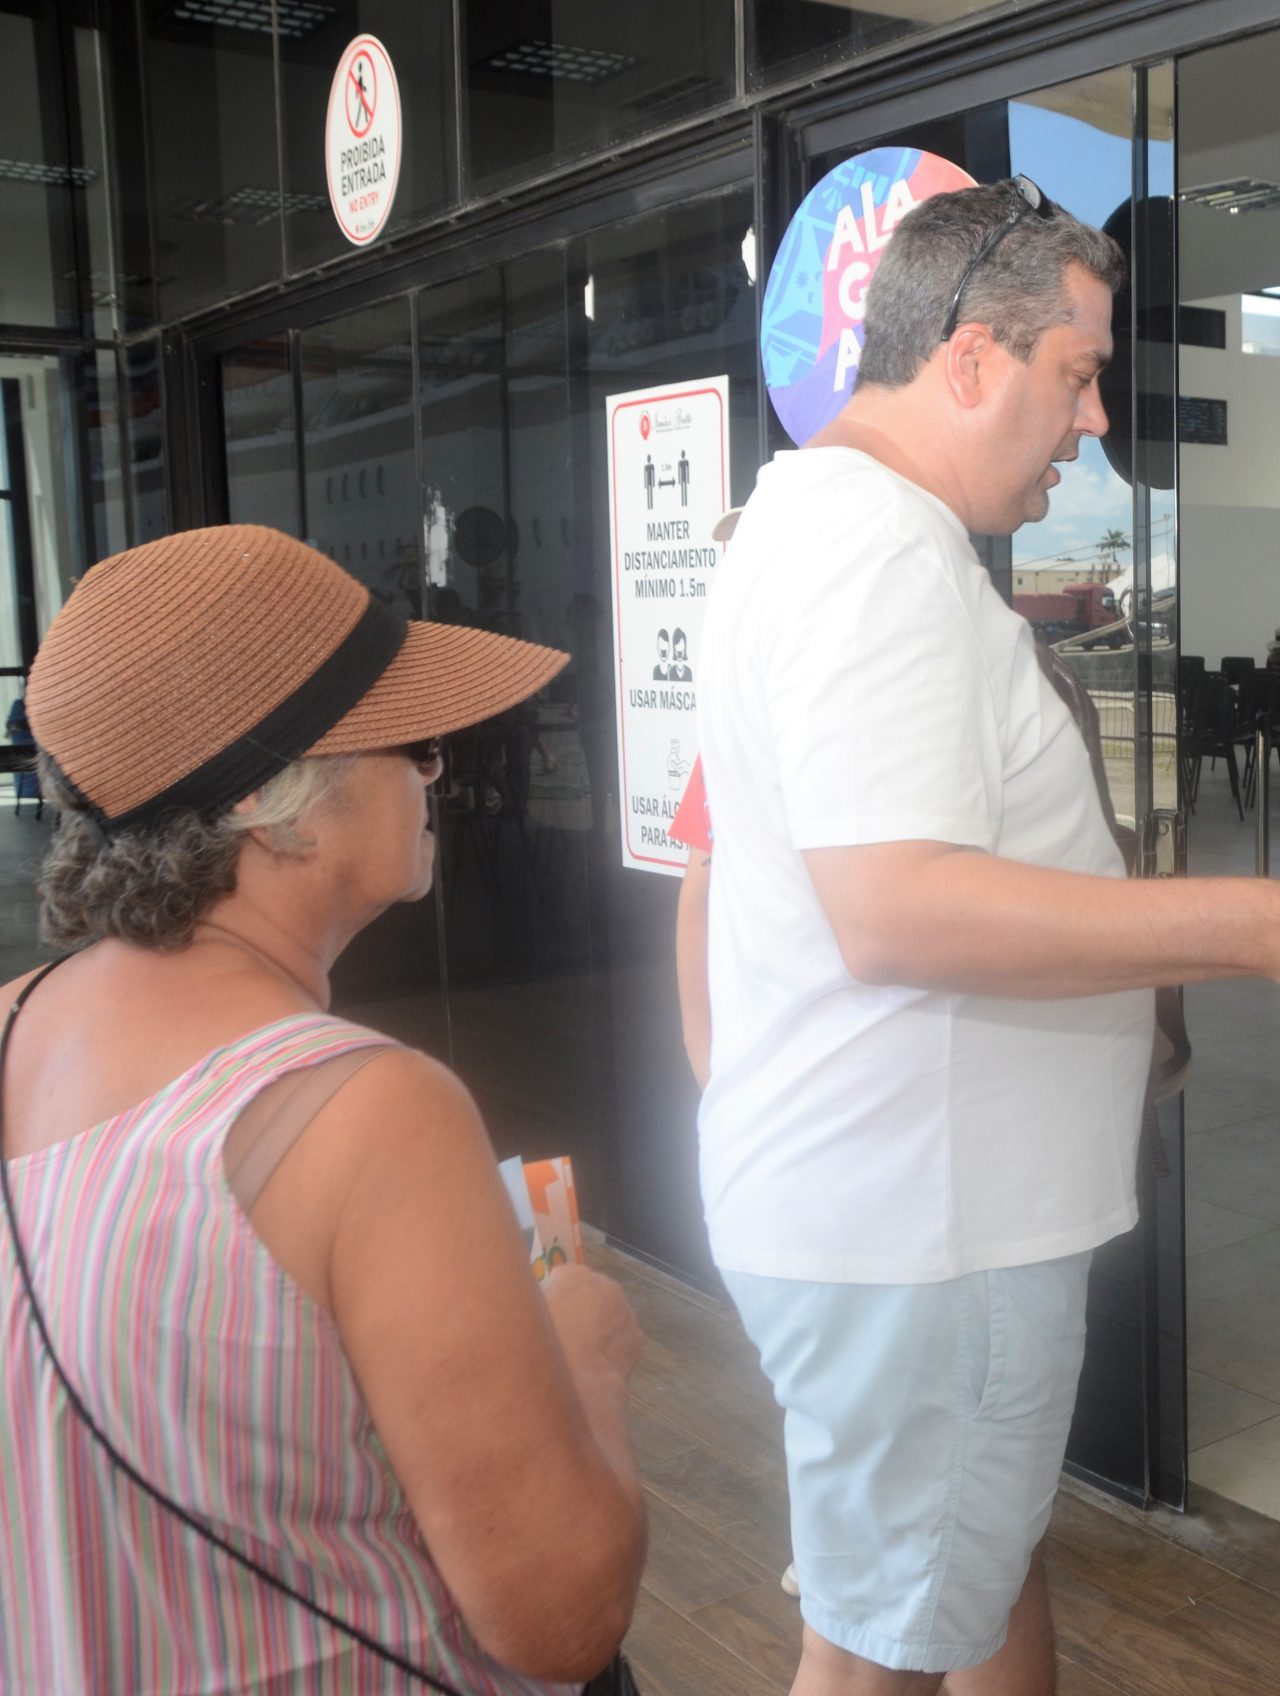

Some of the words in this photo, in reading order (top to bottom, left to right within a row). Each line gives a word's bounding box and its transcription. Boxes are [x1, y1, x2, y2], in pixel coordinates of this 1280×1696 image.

[340, 135, 386, 173] PROIBIDA
[341, 160, 387, 197] ENTRADA
[349, 199, 359, 213] NO
[827, 178, 921, 272] ALA
[838, 261, 870, 321] G
[833, 328, 862, 392] A
[647, 521, 690, 542] MANTER
[624, 548, 716, 571] DISTANCIAMENTO
[635, 574, 676, 598] MÍNIMO
[679, 578, 707, 598] 1.5m
[630, 688, 658, 710] USAR
[659, 686, 697, 711] MÁSCA
[632, 795, 659, 817] USAR
[641, 825, 668, 848] PARA
